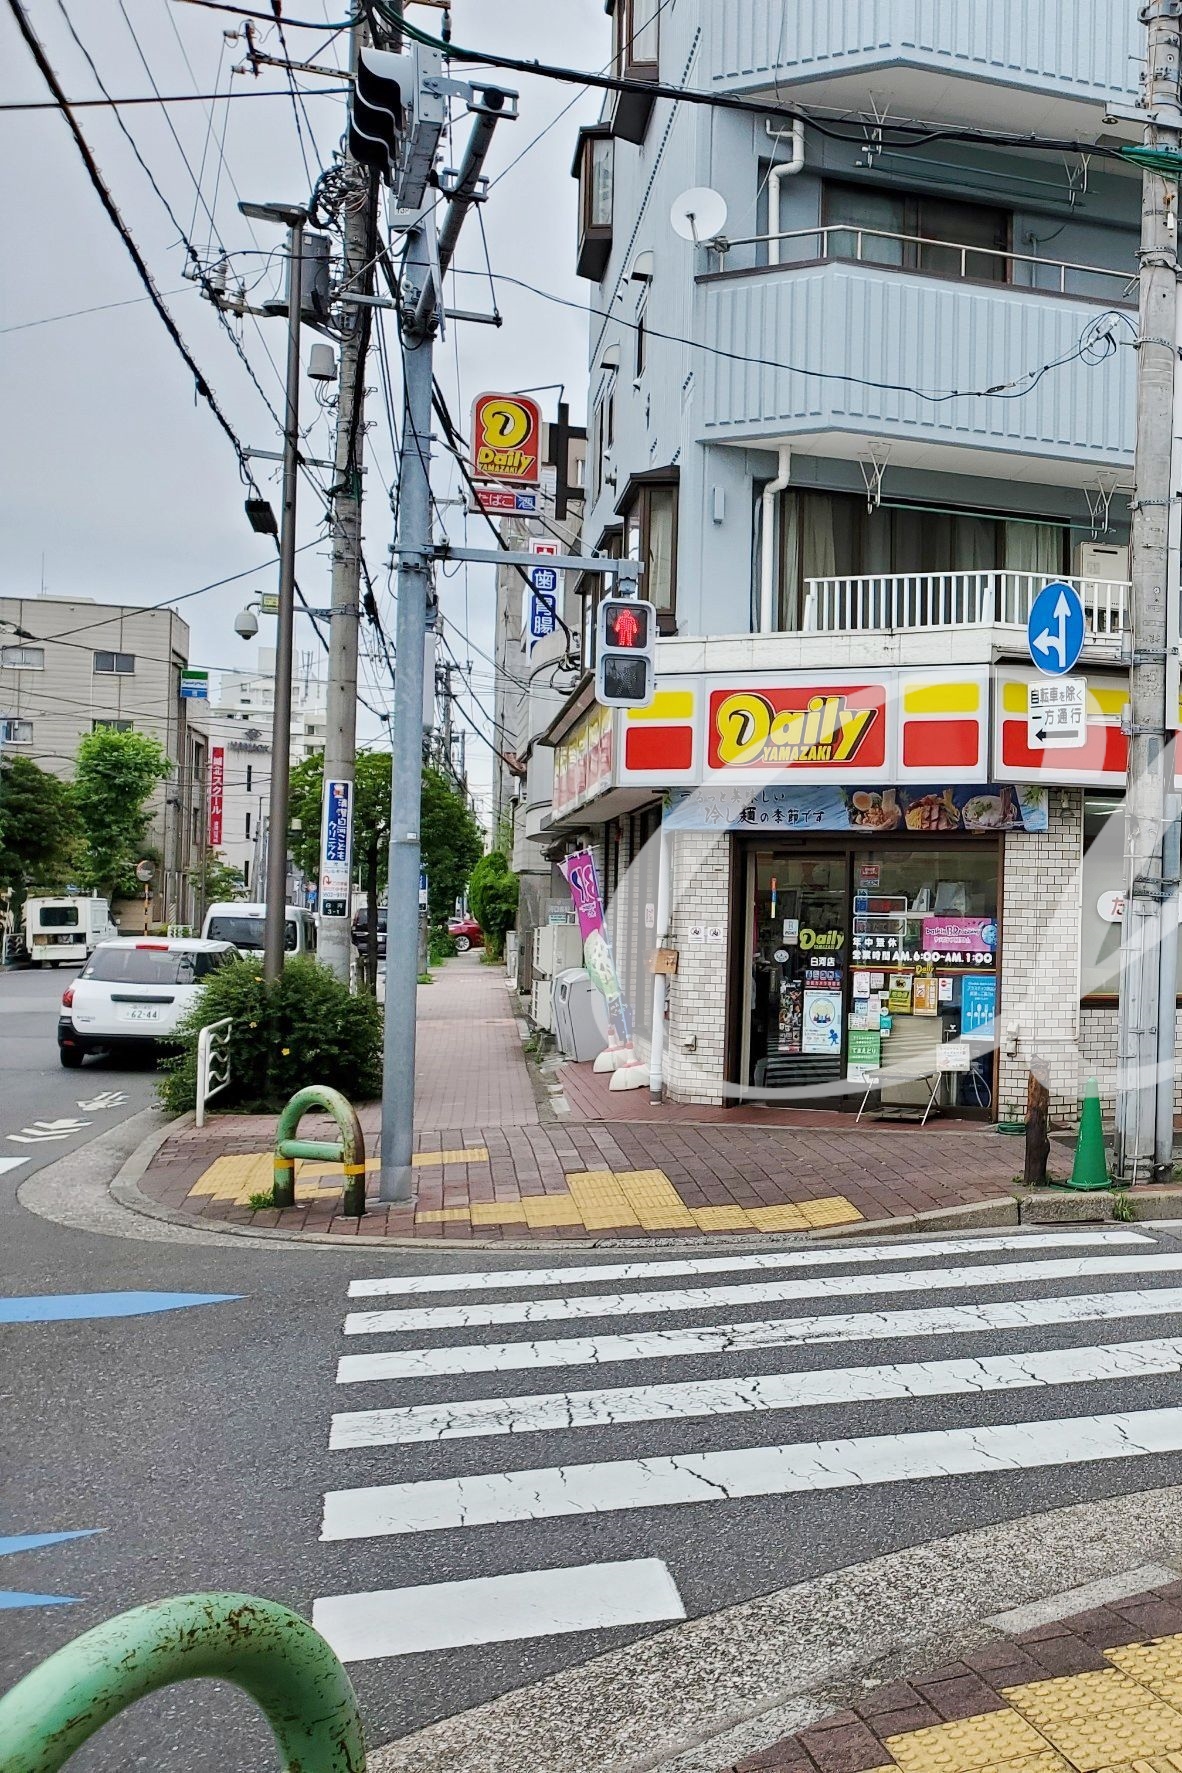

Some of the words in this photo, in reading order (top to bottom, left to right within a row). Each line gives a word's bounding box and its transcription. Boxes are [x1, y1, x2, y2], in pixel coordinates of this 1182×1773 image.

[479, 447, 535, 475] Daily
[517, 494, 536, 510] 酒
[535, 570, 555, 590] 歯
[1030, 685, 1083, 705] 自転車を除く
[1031, 707, 1082, 726] 一方通行
[717, 693, 878, 764] Daily
[763, 745, 832, 762] YAMAZAKI
[327, 820, 337, 859] クリニック
[799, 928, 845, 950] Daily
[852, 937, 898, 947] 年中無休
[810, 956, 835, 967] 白河店
[852, 950, 890, 961] 営業時間
[915, 965, 935, 974] Daily
[131, 1010, 157, 1019] 62-44
